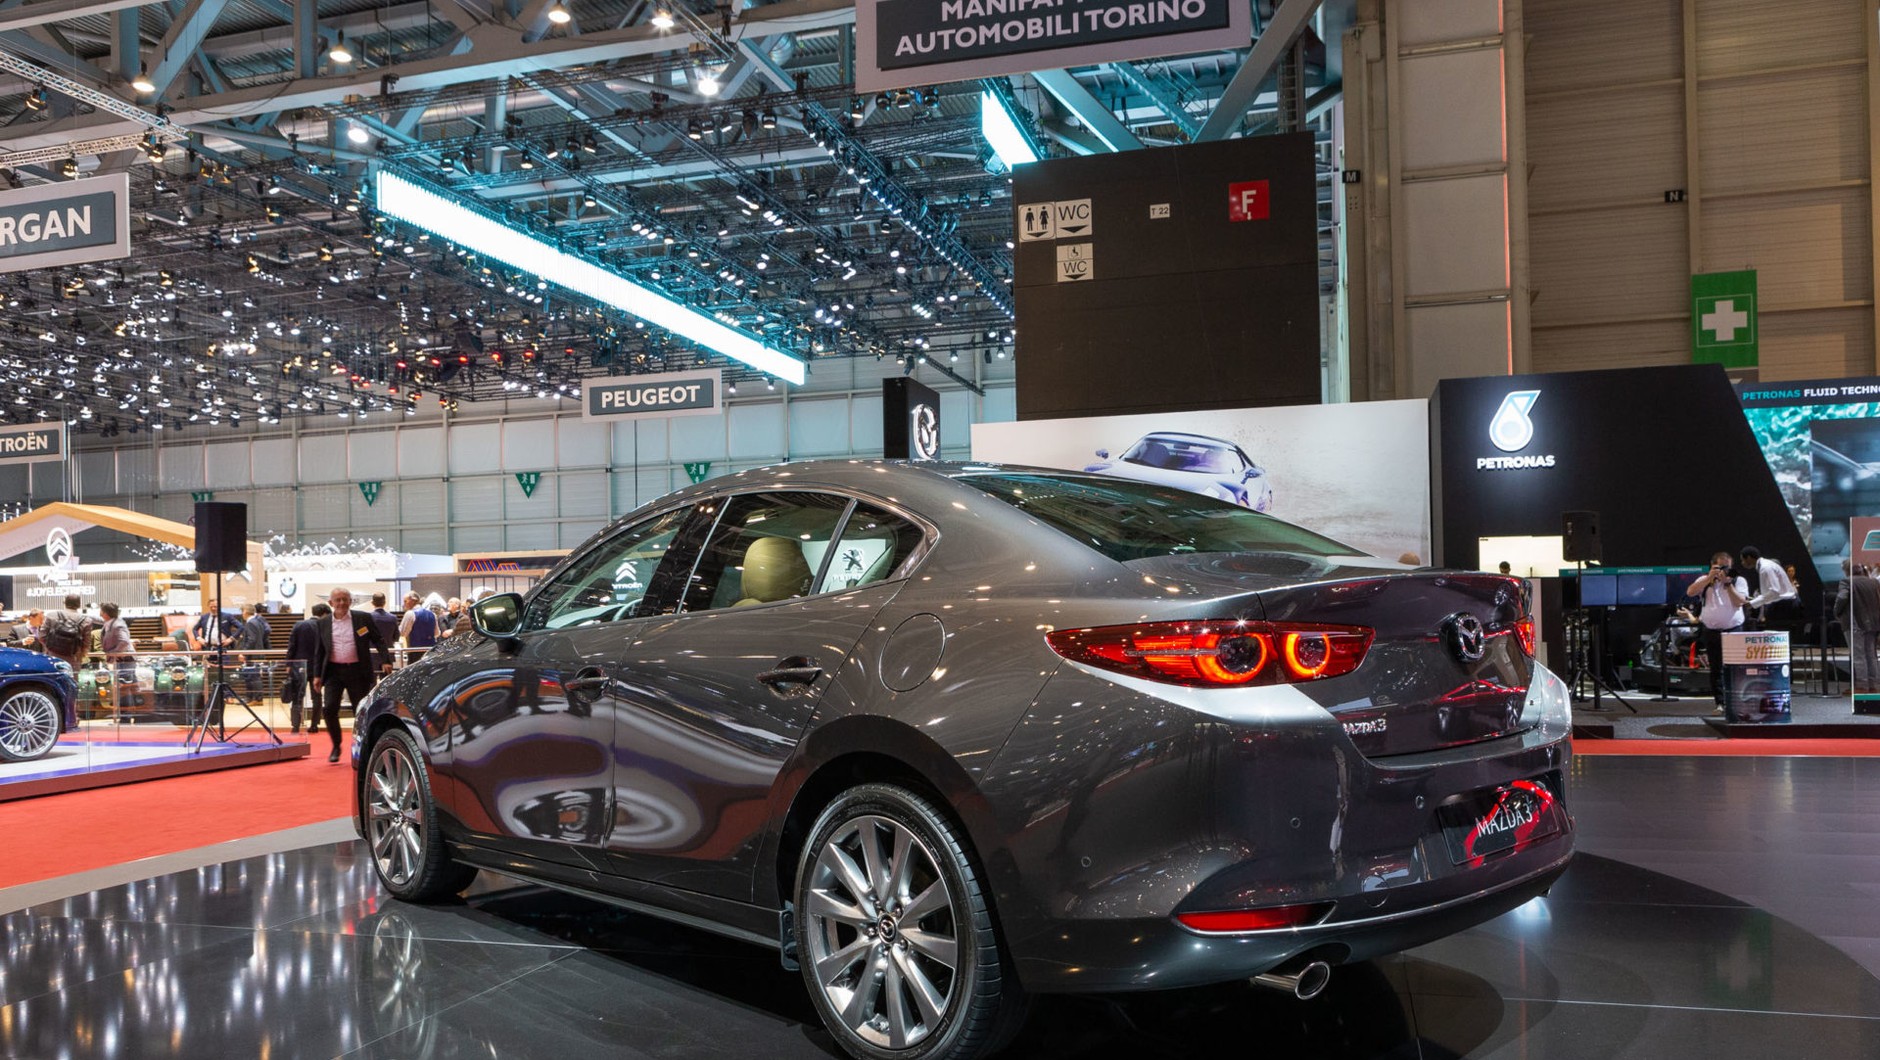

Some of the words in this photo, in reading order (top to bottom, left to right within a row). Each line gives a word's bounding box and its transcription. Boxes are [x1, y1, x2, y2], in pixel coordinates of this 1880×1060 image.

[895, 12, 1079, 57] AUTOMOBILI
[1083, 0, 1206, 31] TORINO
[1346, 171, 1357, 182] M
[1242, 189, 1257, 213] F
[1670, 190, 1679, 201] N
[1058, 203, 1090, 221] WC
[1158, 206, 1169, 215] 22
[0, 205, 91, 246] RGAN
[1063, 260, 1088, 273] WC
[601, 385, 701, 408] PEUGEOT
[1742, 389, 1801, 400] PETRONAS
[1804, 387, 1838, 397] FLUID
[1477, 454, 1556, 470] PETRONAS
